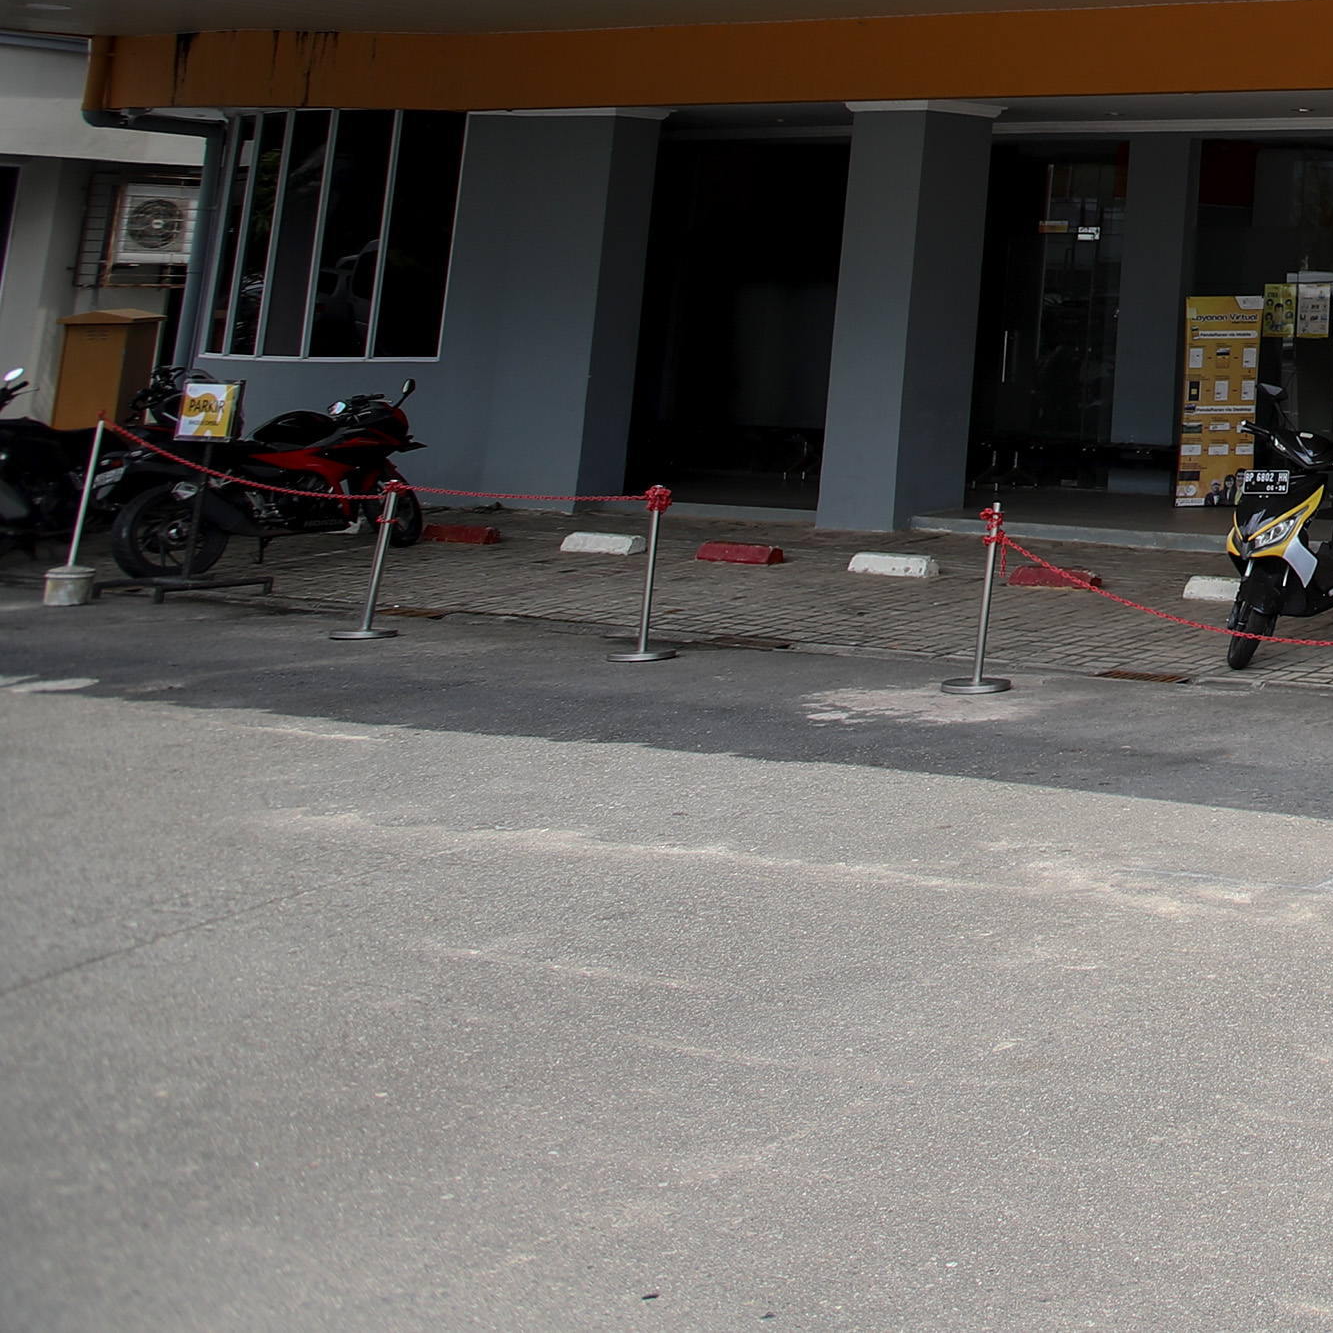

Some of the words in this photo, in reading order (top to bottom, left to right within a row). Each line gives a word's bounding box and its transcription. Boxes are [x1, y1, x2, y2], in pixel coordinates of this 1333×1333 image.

[1230, 313, 1258, 321] Virtual
[188, 398, 226, 414] PARKIR
[1244, 472, 1255, 482] BP
